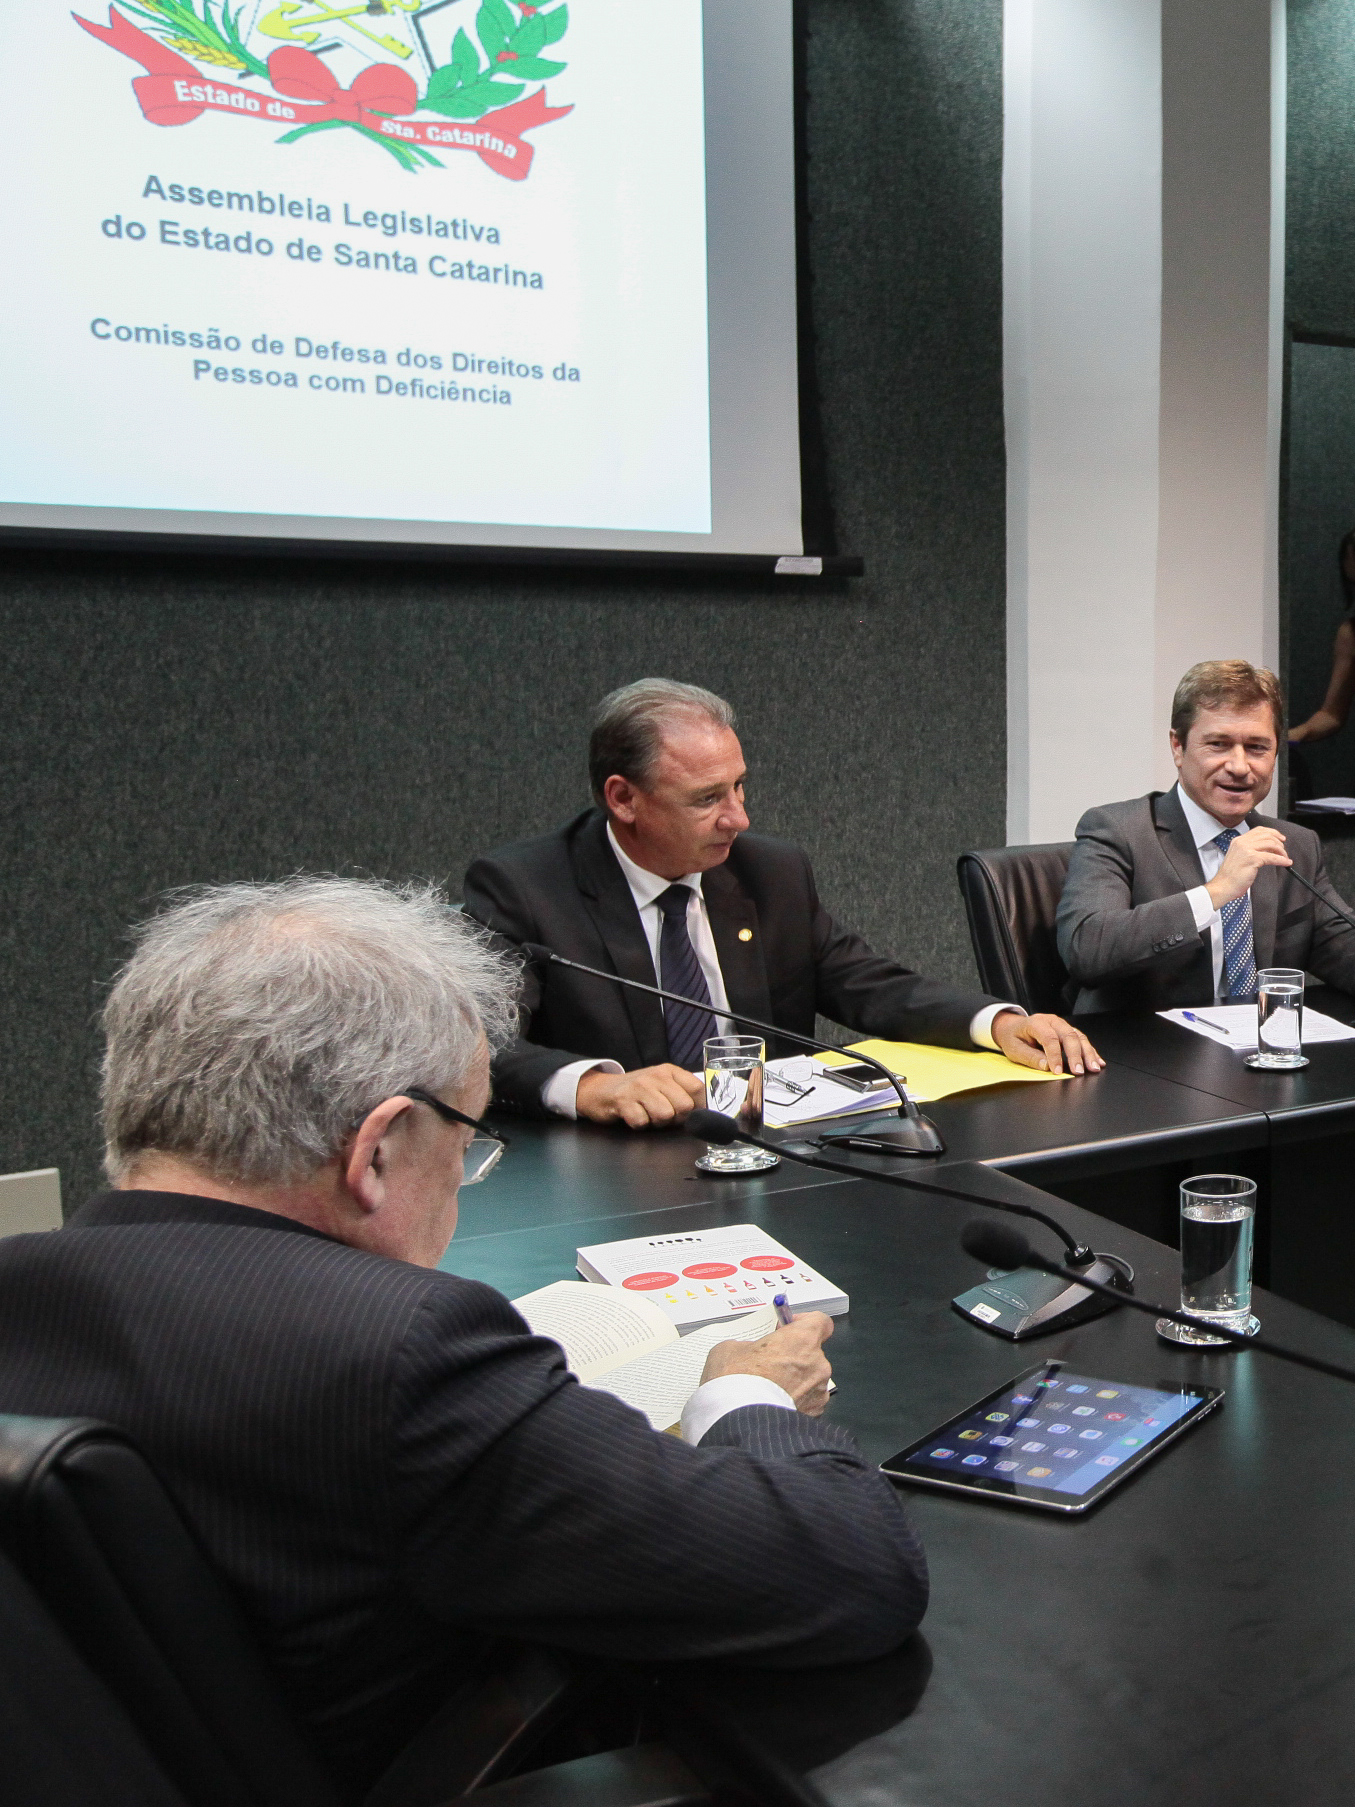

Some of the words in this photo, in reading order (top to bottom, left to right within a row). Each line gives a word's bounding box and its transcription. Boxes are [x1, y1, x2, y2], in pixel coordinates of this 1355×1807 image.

[173, 80, 261, 112] Estado
[266, 101, 296, 119] de
[380, 119, 422, 139] Sta.
[426, 126, 518, 159] Catarina
[143, 175, 333, 224] Assembleia
[344, 203, 502, 246] Legislativa
[101, 215, 148, 243] do
[159, 220, 275, 258] Estado
[286, 238, 324, 264] de
[335, 243, 419, 275] Santa
[429, 255, 545, 291] Catarina
[90, 318, 242, 353] Comissão
[252, 334, 286, 357] de
[295, 337, 388, 366] Defesa
[397, 348, 444, 372] dos
[453, 353, 545, 381] Direitos
[553, 363, 582, 383] da
[194, 359, 300, 389] Pessoa
[309, 375, 367, 395] com
[376, 375, 513, 406] Deficiência
